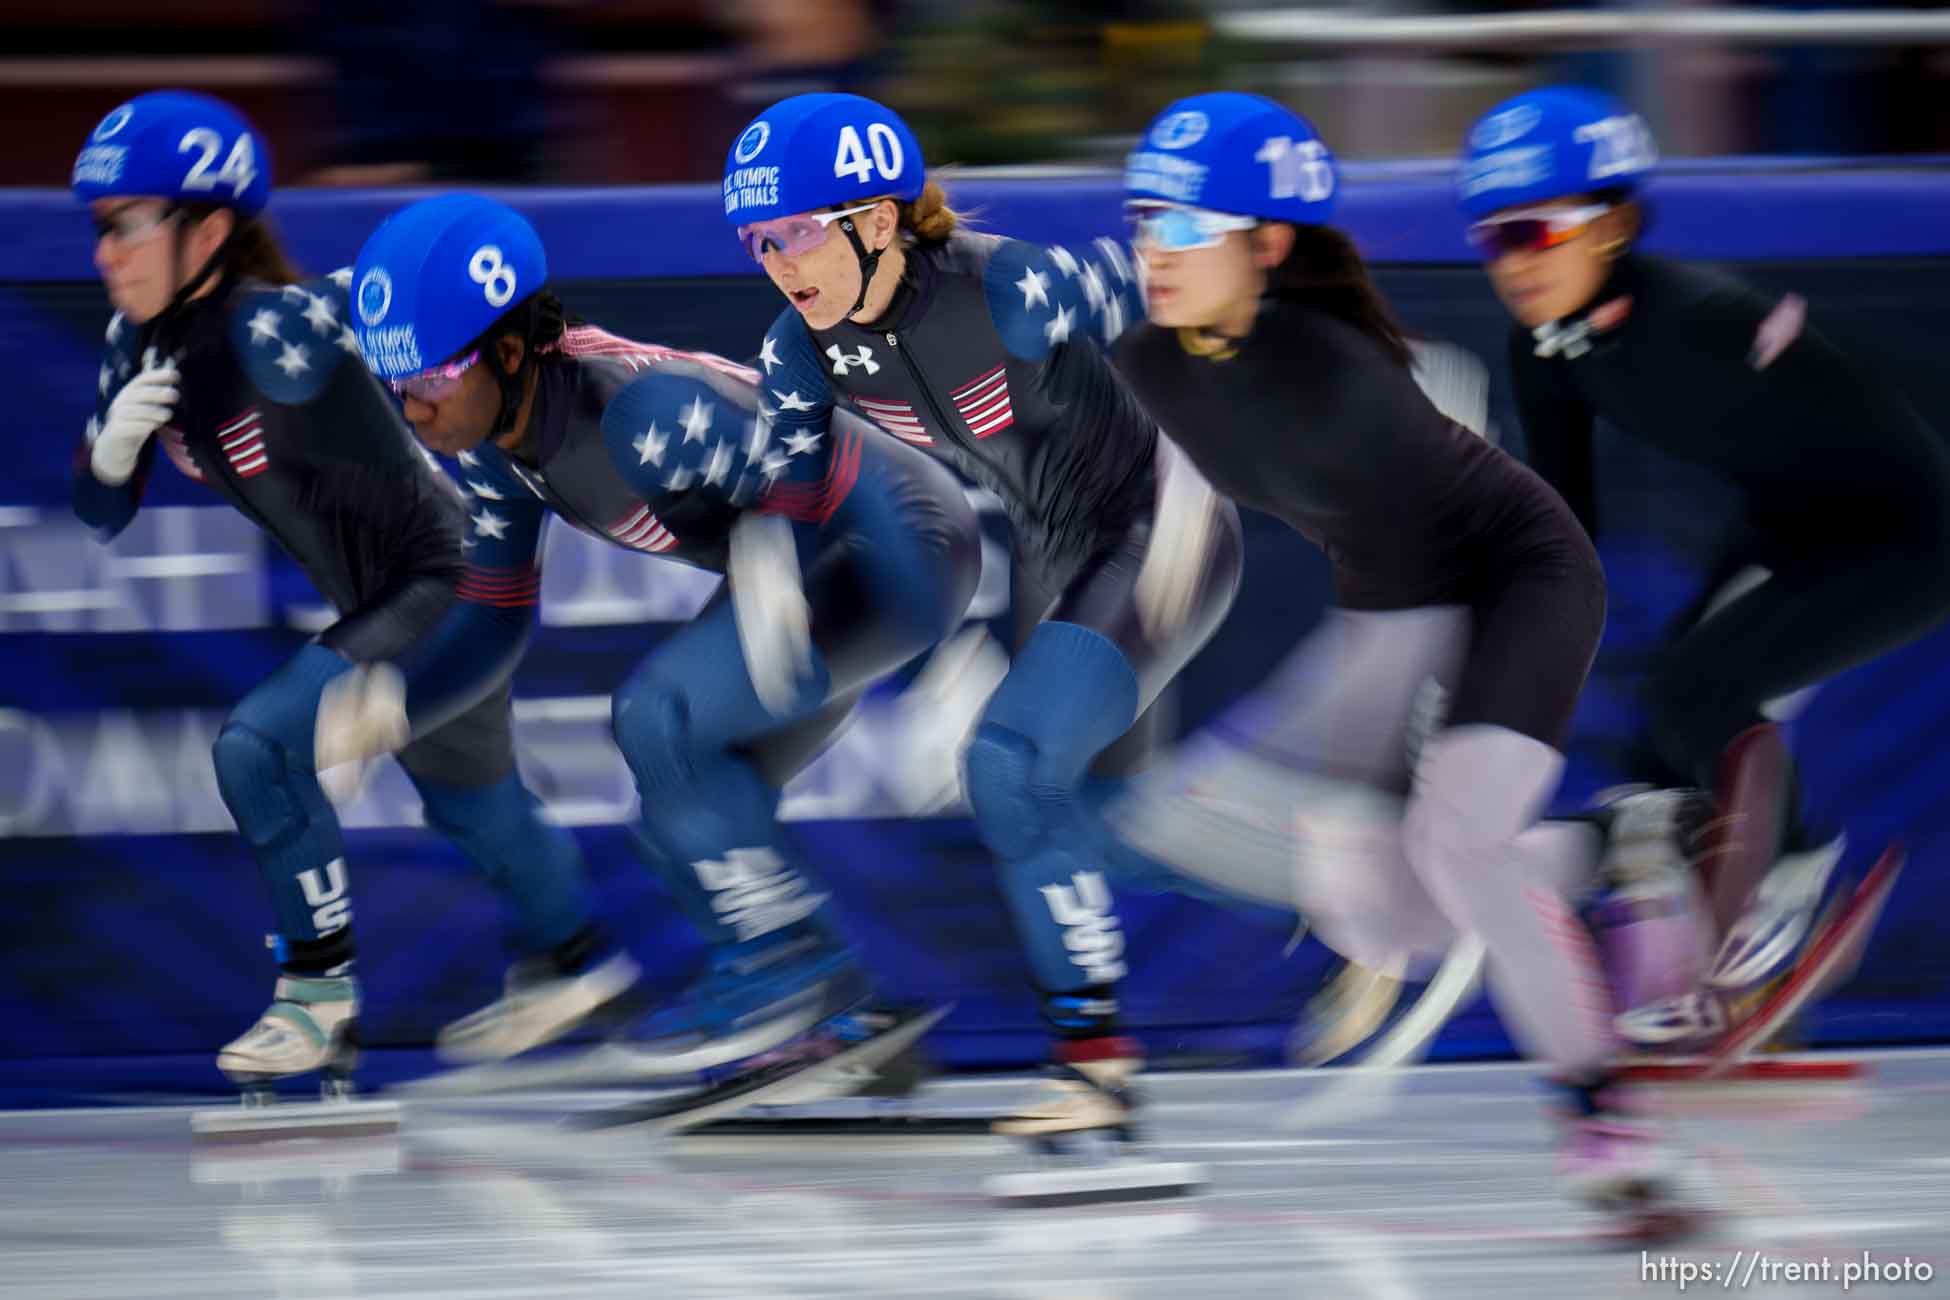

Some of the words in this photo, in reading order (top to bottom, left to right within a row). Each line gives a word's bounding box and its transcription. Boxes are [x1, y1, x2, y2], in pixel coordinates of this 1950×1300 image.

[177, 126, 258, 199] 24
[734, 166, 780, 189] OLYMPIC
[834, 123, 904, 183] 40
[740, 185, 779, 209] TRIALS
[468, 244, 516, 308] 8
[295, 856, 354, 938] US
